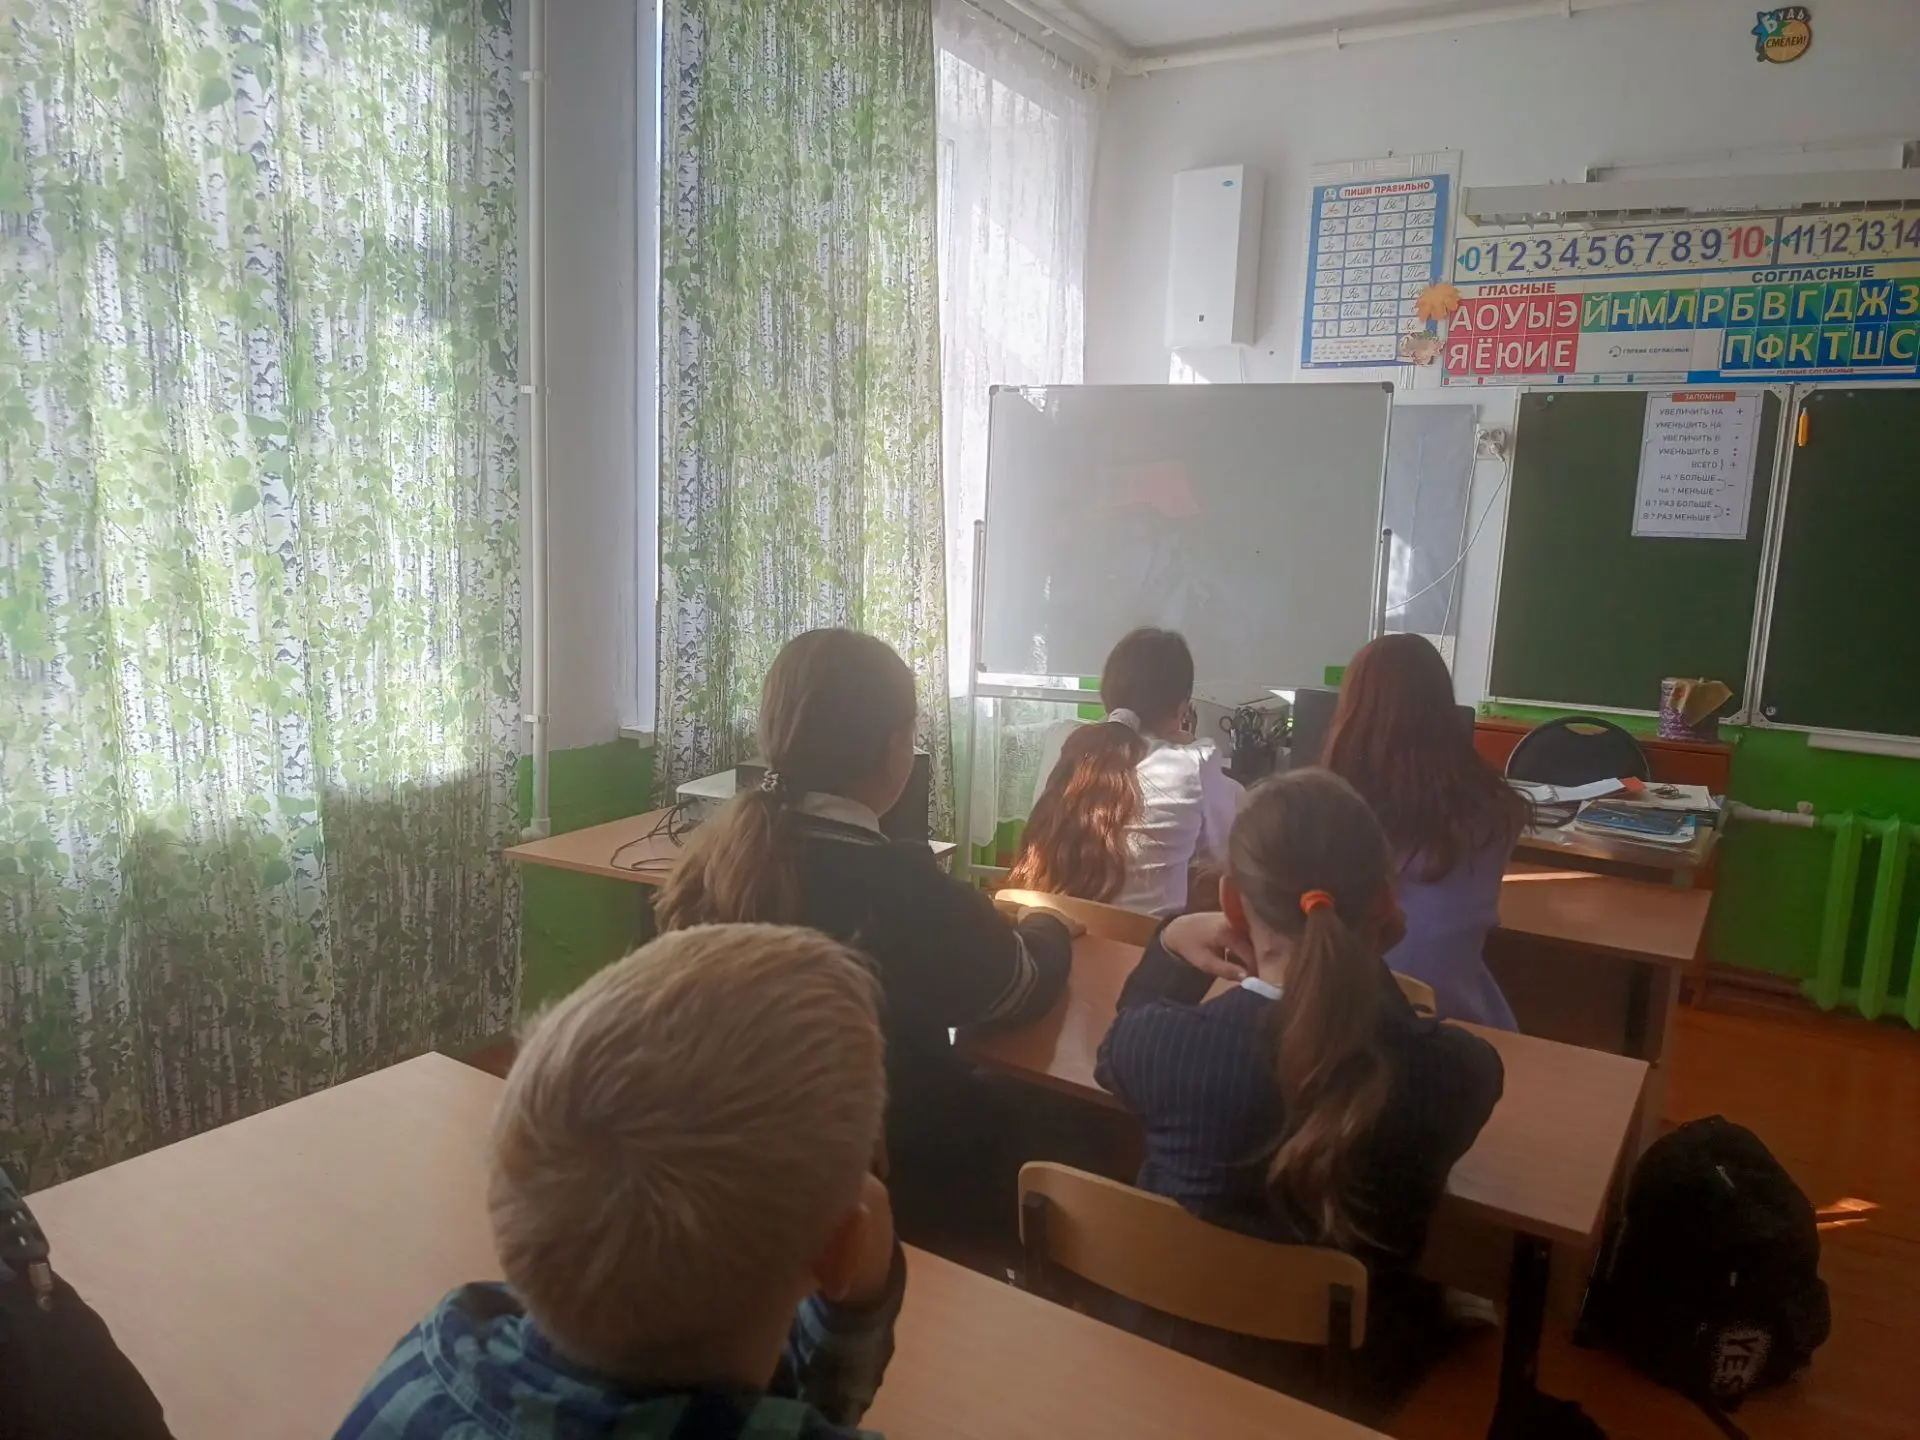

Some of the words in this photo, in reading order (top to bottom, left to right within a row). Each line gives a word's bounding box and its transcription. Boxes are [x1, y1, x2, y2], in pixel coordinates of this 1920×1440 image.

[1766, 35, 1806, 48] СМЕЛЕЙ!
[1344, 187, 1372, 197] ПИШИ
[1374, 182, 1430, 194] ПРАВИЛЬНО
[1790, 224, 1815, 254] 11
[1821, 223, 1851, 253] 12
[1856, 221, 1885, 251] 13
[1464, 246, 1481, 272] 0
[1486, 243, 1499, 272] 1
[1507, 242, 1527, 271] 2
[1534, 240, 1552, 270] 3
[1558, 238, 1580, 267] 4
[1587, 237, 1607, 266] 5
[1614, 235, 1635, 265] 6
[1644, 232, 1664, 263] 7
[1671, 231, 1692, 262] 8
[1701, 228, 1722, 260] 9
[1727, 225, 1765, 260] 10
[1752, 266, 1875, 284] СОГЛАСНЫЕ
[1478, 282, 1556, 296] ГЛАСНЫЕ
[1684, 392, 1724, 401] ЗАПОМНИ
[1659, 408, 1710, 416] УВЕЛИЧИТЬ
[1711, 407, 1724, 415] НА
[1655, 421, 1708, 429] УМЕНЬШИТЬ
[1662, 434, 1712, 442] УВЕЛИЧИТЬ
[1691, 461, 1718, 469] ВСЕГО
[1677, 487, 1714, 495] МЕНЬШЕ
[1676, 500, 1712, 508] БОЛЬШЕ
[1674, 513, 1711, 521] МЕНЬШЕ
